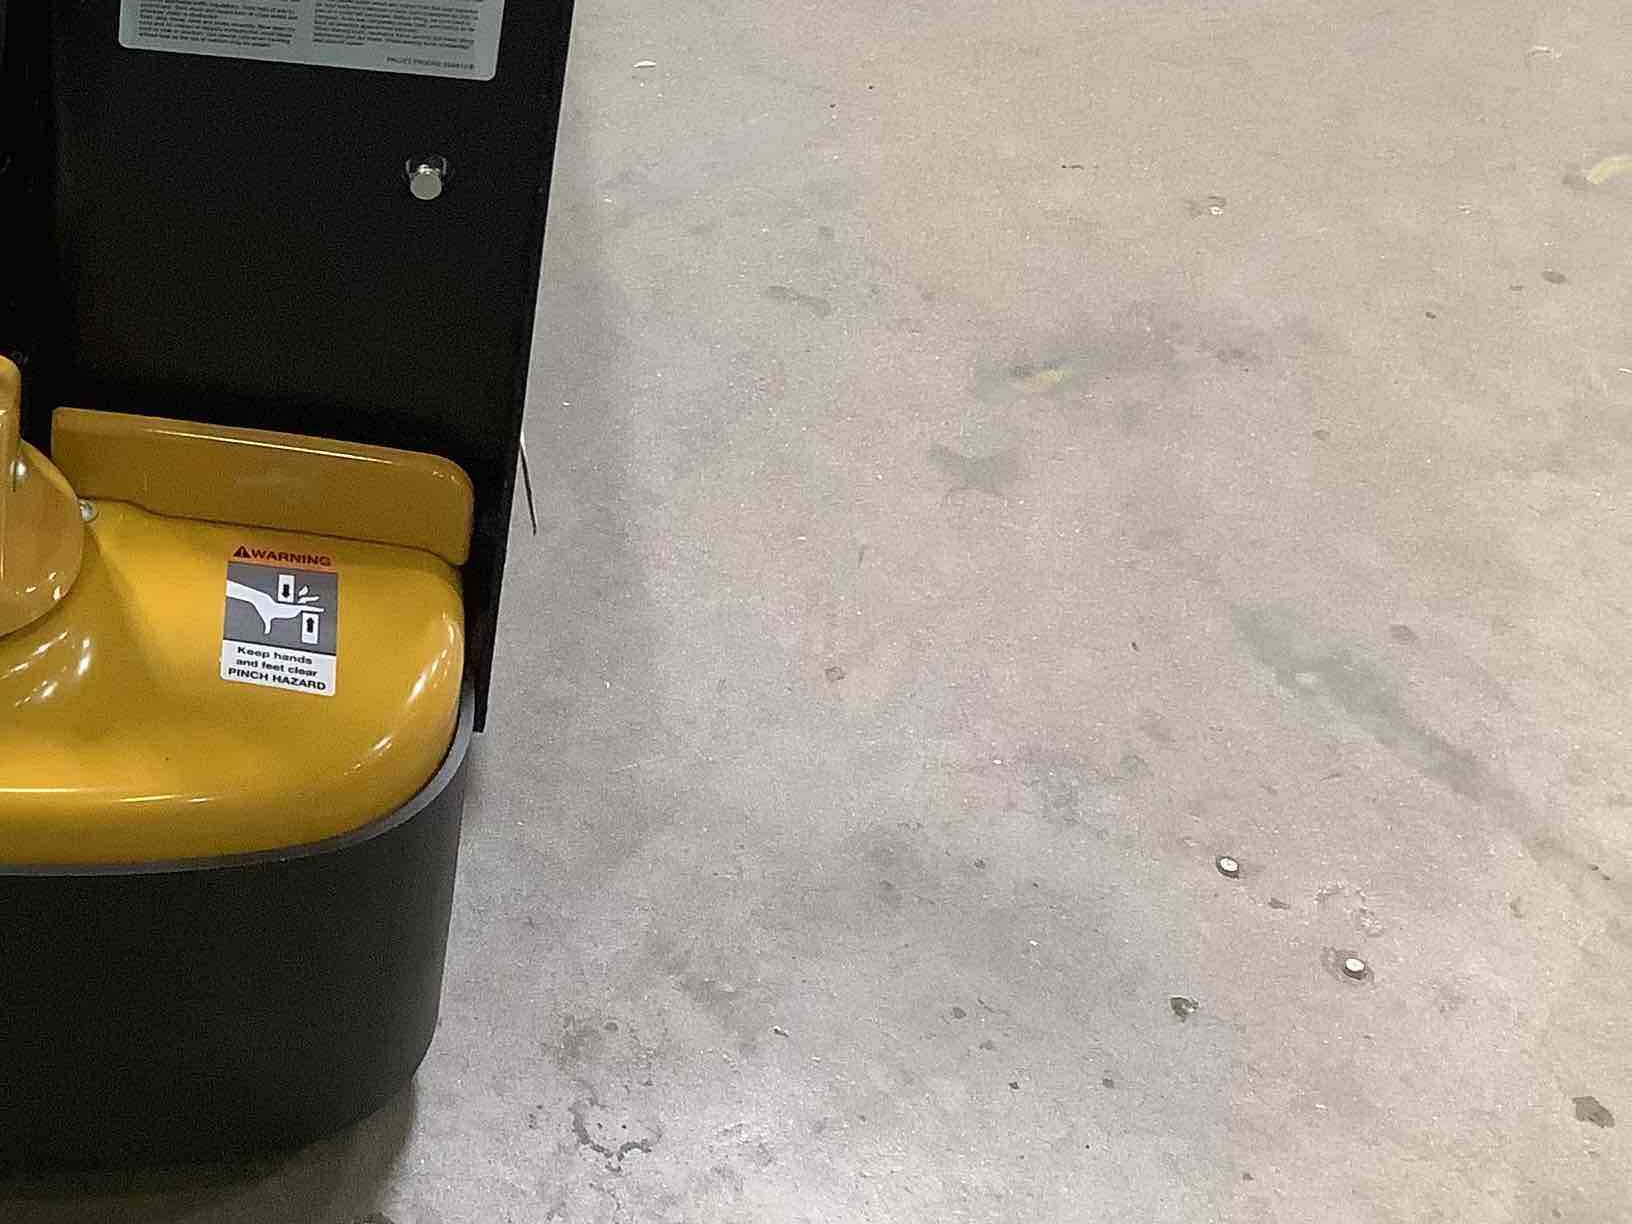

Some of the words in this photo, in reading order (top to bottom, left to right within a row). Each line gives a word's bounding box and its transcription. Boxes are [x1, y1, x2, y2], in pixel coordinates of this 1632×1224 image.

[251, 549, 331, 566] WARNING
[237, 646, 270, 659] Keep
[274, 650, 313, 664] hands
[236, 658, 258, 668] and
[262, 661, 285, 672] feet
[288, 665, 318, 676] clear
[228, 668, 268, 681] PINCH
[272, 675, 326, 691] HAZARD
